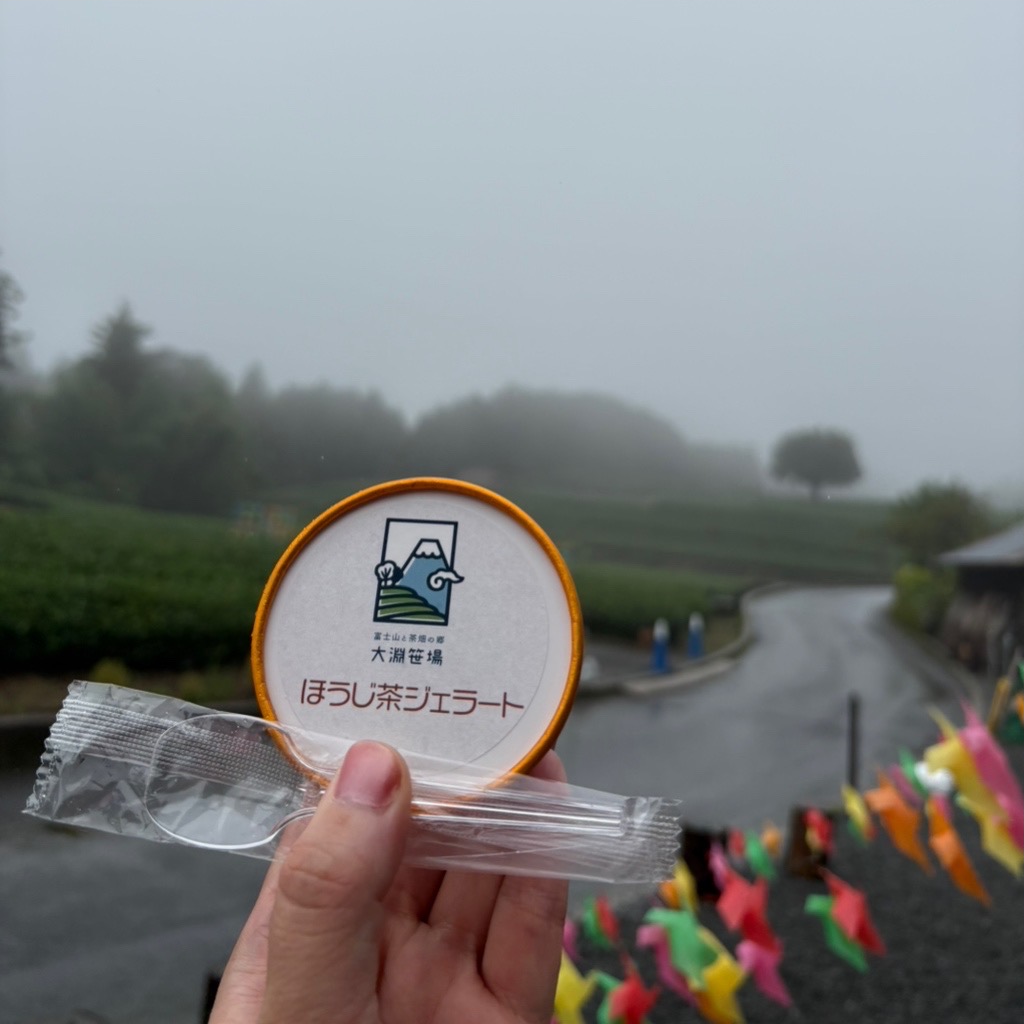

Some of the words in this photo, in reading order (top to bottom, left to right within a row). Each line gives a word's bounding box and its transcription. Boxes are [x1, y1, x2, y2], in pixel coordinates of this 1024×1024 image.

[373, 632, 445, 644] 富士山と茶畑の郷
[371, 647, 443, 665] 大淵笹場
[298, 678, 526, 718] ほうじ茶ジェラート
